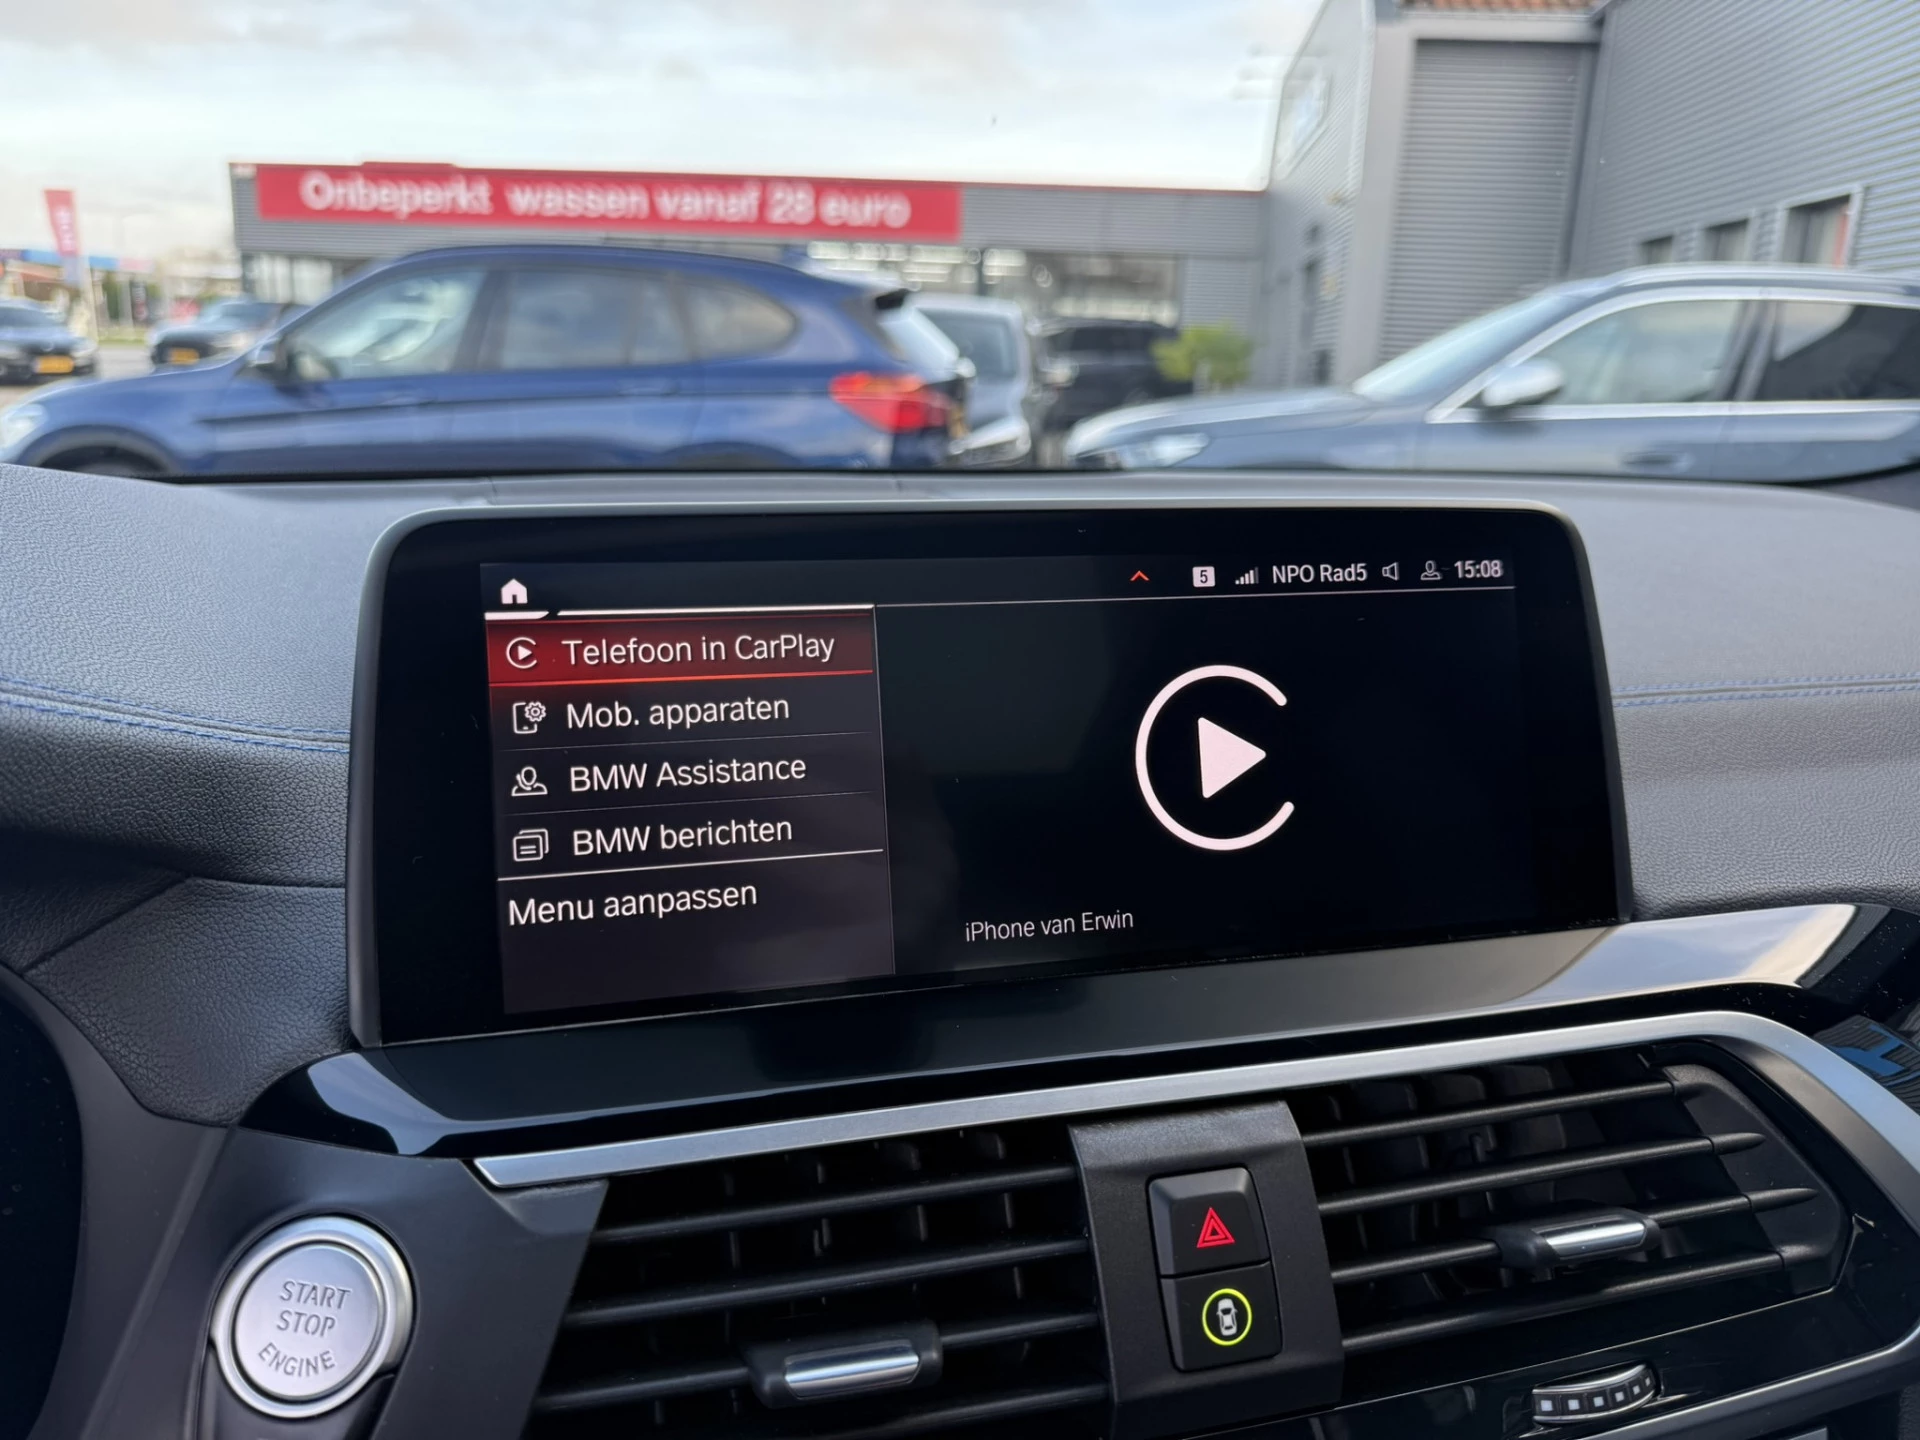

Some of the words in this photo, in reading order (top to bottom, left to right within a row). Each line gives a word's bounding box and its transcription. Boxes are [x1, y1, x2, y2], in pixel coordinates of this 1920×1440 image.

[301, 171, 493, 221] Onbeperkt
[505, 179, 650, 219] wassen
[653, 179, 763, 223] vanaf
[764, 179, 816, 226] 28
[820, 188, 911, 229] euro
[1272, 564, 1315, 584] NPO
[1319, 563, 1368, 583] Rad5
[1453, 559, 1503, 579] 15:08
[562, 636, 692, 666] Telefoon
[701, 635, 726, 662] in
[735, 633, 835, 663] CarPlay
[566, 702, 640, 730] Mob.
[649, 696, 790, 730] apparaten
[570, 763, 647, 793] BMW
[656, 757, 807, 788] Assistance
[572, 826, 651, 856] BMW
[660, 819, 793, 850] berichten
[508, 895, 594, 926] Menu
[603, 884, 757, 918] aanpassen
[965, 920, 1035, 942] iPhone
[1040, 916, 1076, 935] van
[1081, 909, 1134, 931] Erwin
[279, 1280, 351, 1310] START
[276, 1309, 336, 1338] STOP
[257, 1341, 336, 1377] ENGINE
